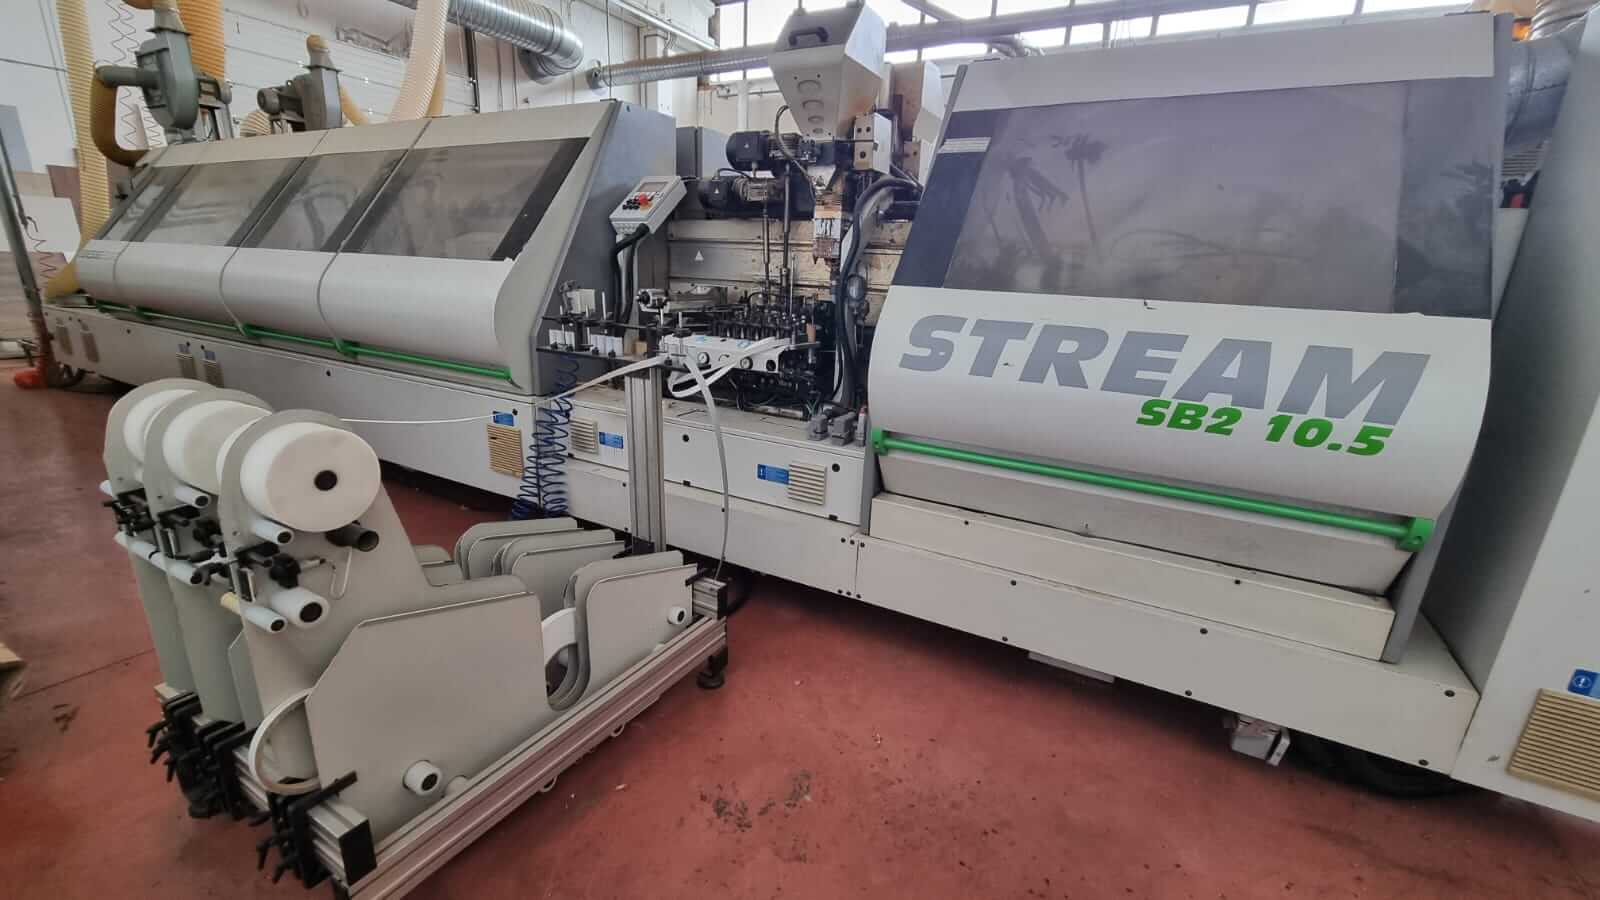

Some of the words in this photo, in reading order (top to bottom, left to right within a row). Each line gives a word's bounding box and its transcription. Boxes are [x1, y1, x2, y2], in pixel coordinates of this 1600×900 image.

[898, 314, 1432, 427] STREAM
[1136, 399, 1242, 434] SB2
[1267, 415, 1392, 457] 10.5
